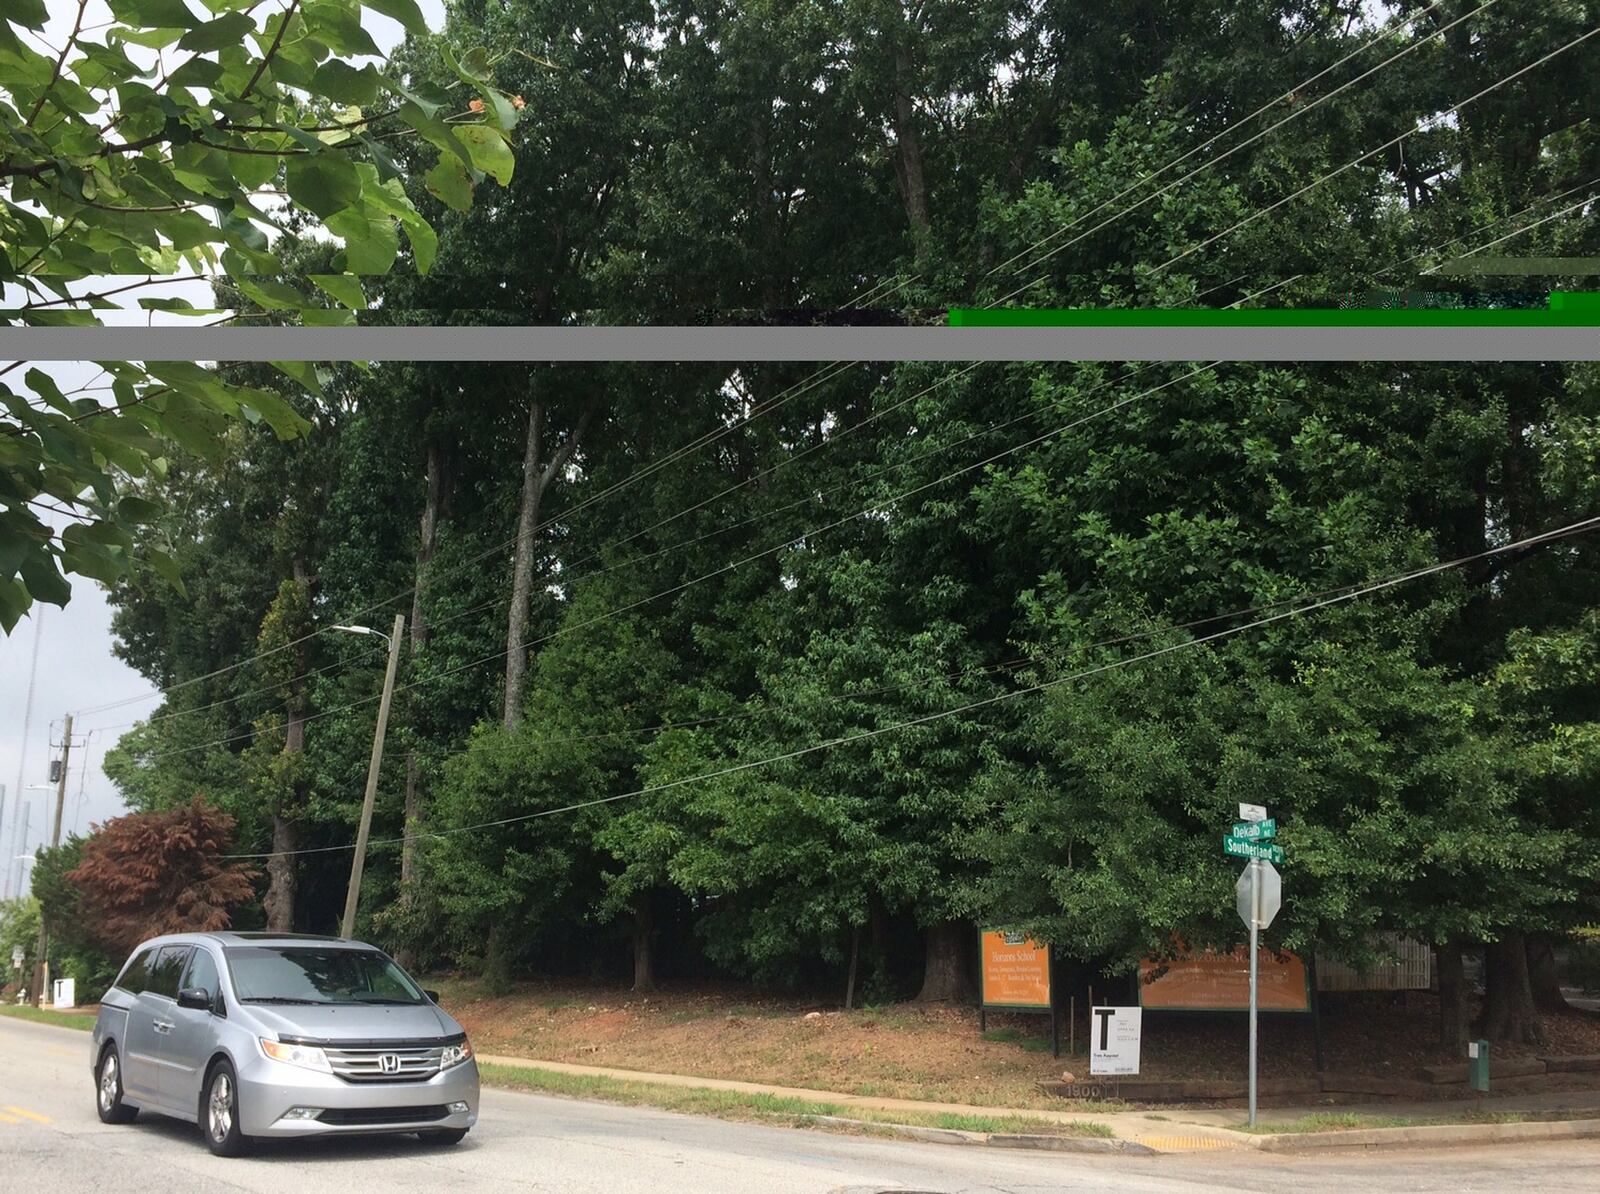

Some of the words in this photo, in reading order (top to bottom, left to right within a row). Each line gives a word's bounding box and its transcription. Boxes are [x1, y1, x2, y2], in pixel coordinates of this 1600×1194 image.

[1228, 838, 1272, 860] Southerland
[1017, 950, 1036, 962] School
[56, 980, 64, 998] T
[1094, 1009, 1116, 1050] T
[1066, 1084, 1100, 1097] 1900
